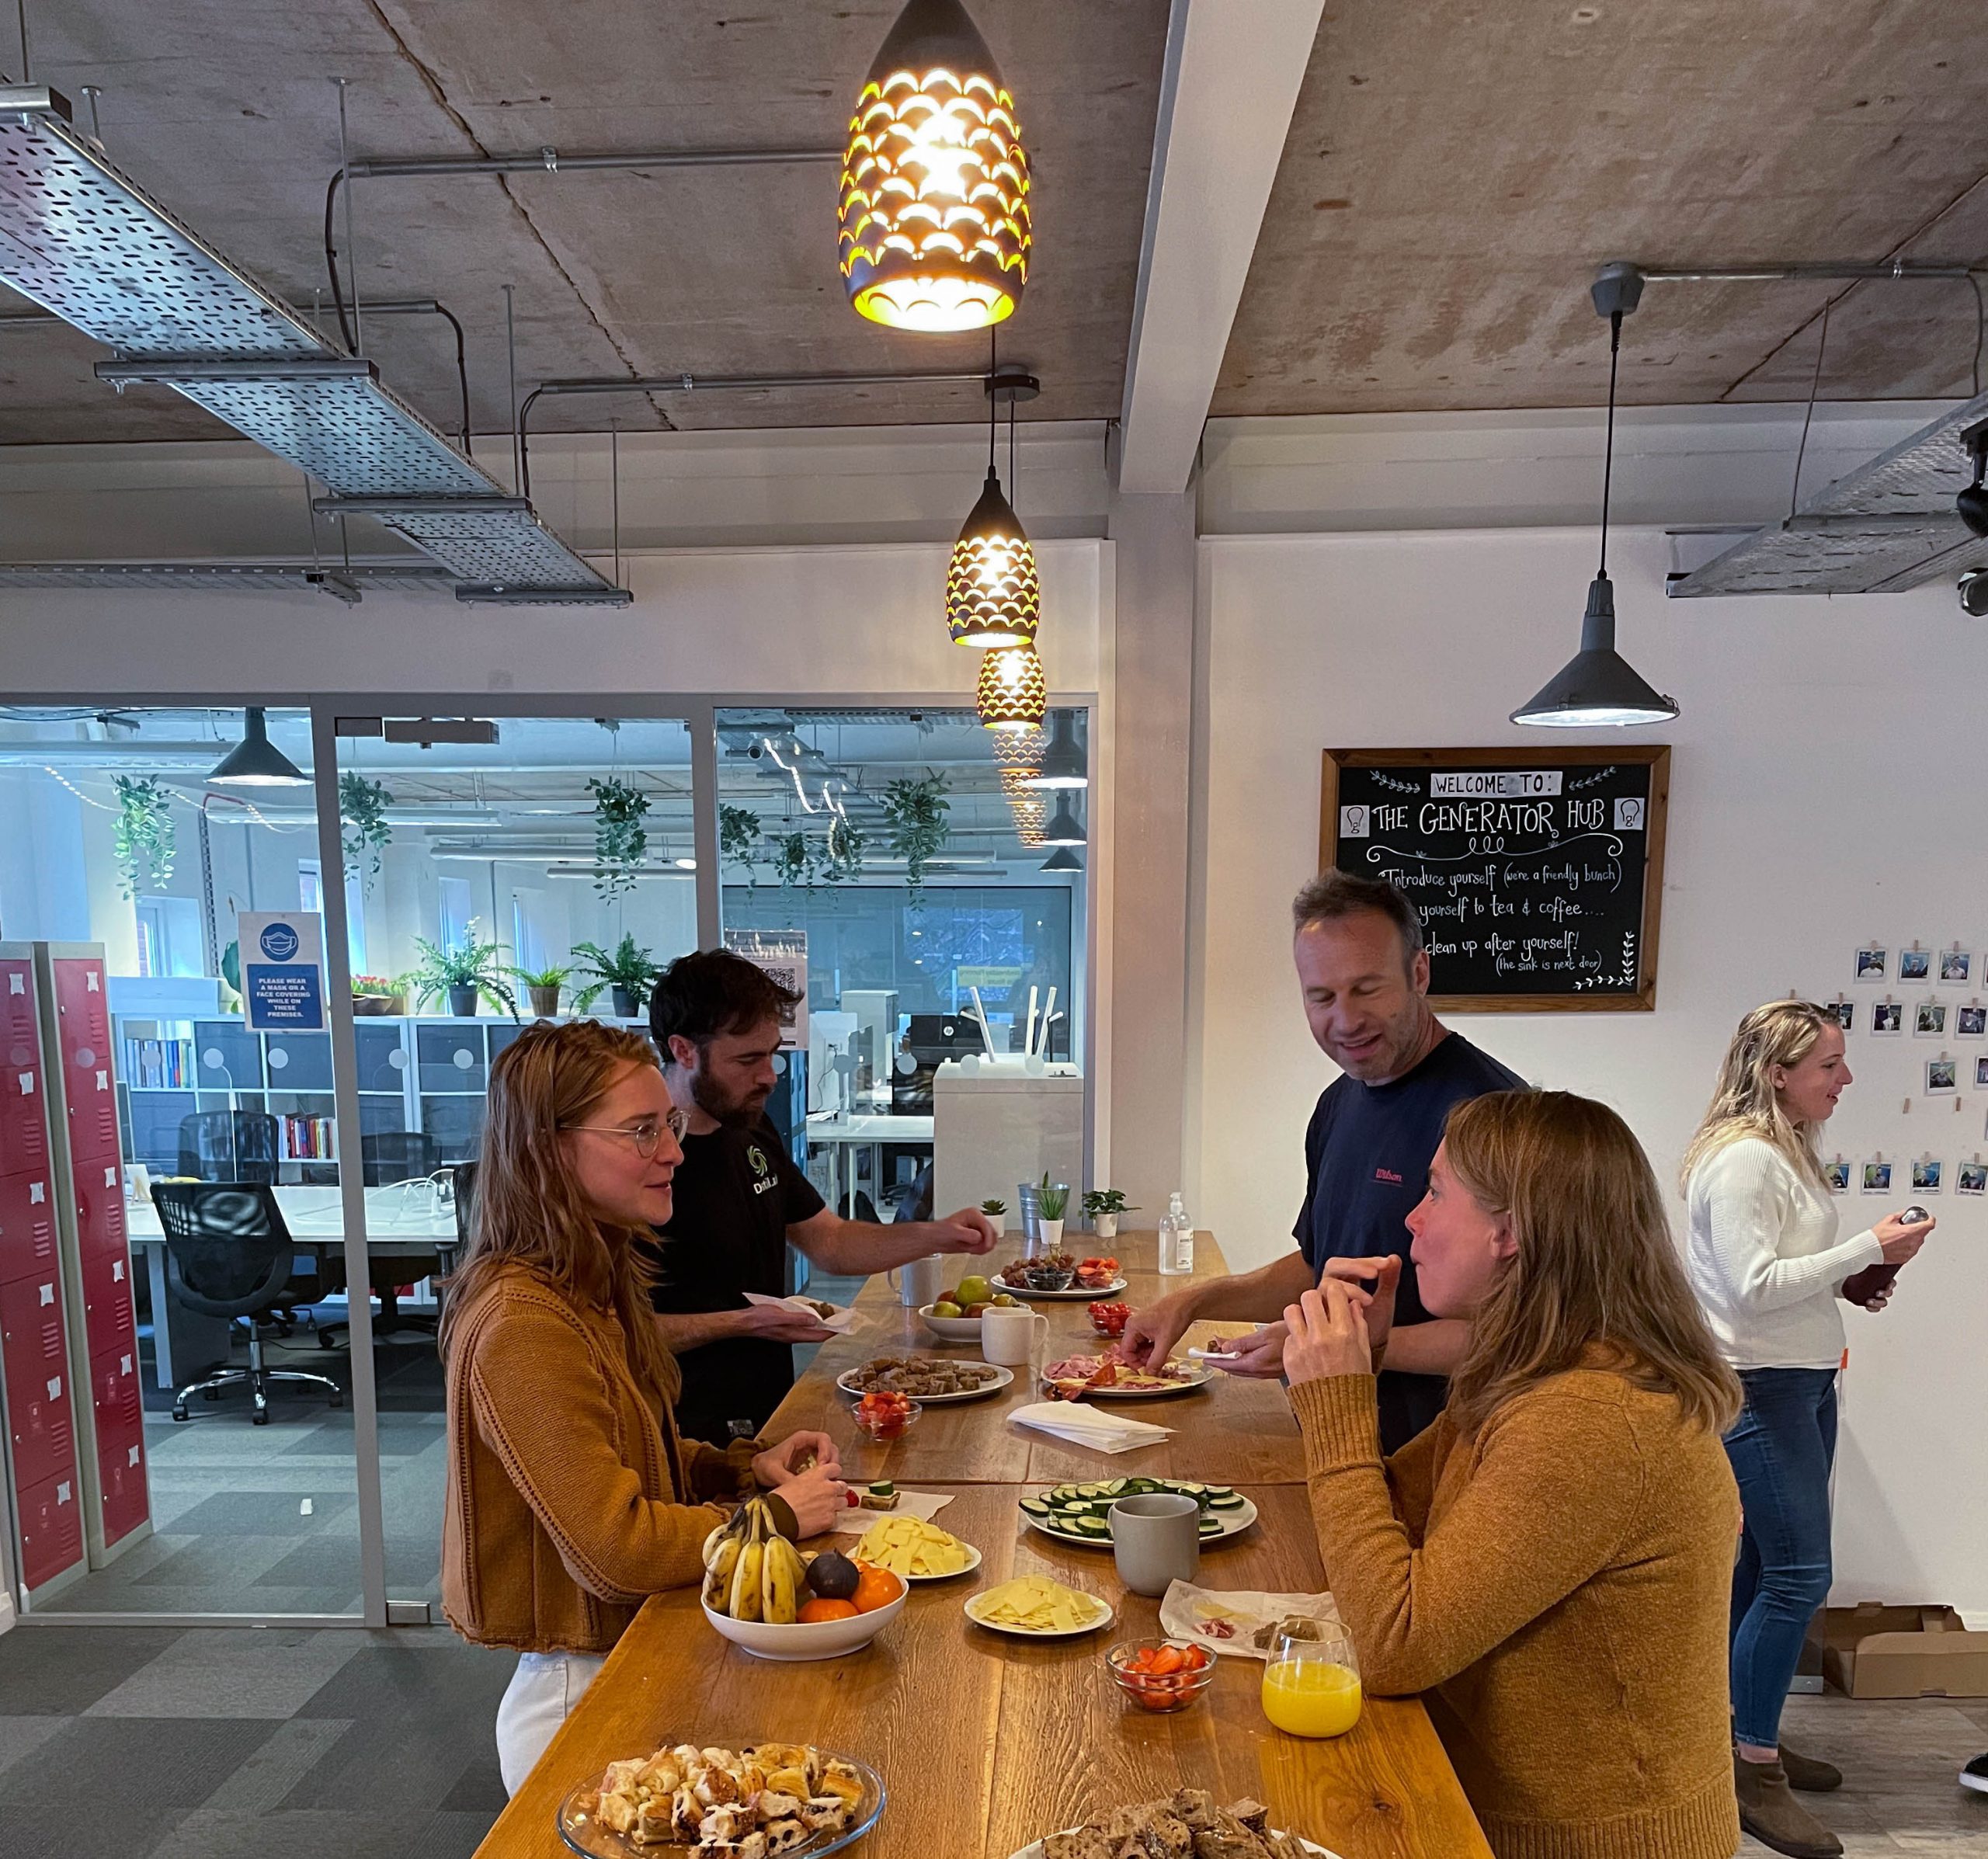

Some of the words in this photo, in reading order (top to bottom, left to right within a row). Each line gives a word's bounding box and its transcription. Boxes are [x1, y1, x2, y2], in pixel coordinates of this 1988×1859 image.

[1436, 776, 1507, 794] WELCOME
[1520, 774, 1552, 792] TO:
[1371, 804, 1408, 830] THE
[1419, 801, 1559, 838] GENERATOR
[1567, 798, 1604, 830] HUB
[1378, 864, 1445, 889] Introduce
[1448, 864, 1496, 897] yourself
[1533, 871, 1539, 880] a
[1543, 863, 1579, 891] friendly
[1584, 857, 1621, 893] bunch)
[1418, 896, 1469, 926] yourself
[1474, 897, 1485, 915] to
[1489, 895, 1514, 916] tea
[1522, 898, 1531, 916] &
[1425, 931, 1456, 956] clean
[1462, 940, 1477, 958] up
[1485, 933, 1515, 956] after
[1521, 930, 1579, 961] yourself!
[1496, 952, 1515, 977] (the
[1518, 957, 1538, 971] sink
[1541, 959, 1550, 970] is
[1554, 956, 1576, 970] next
[1579, 949, 1602, 974] door)
